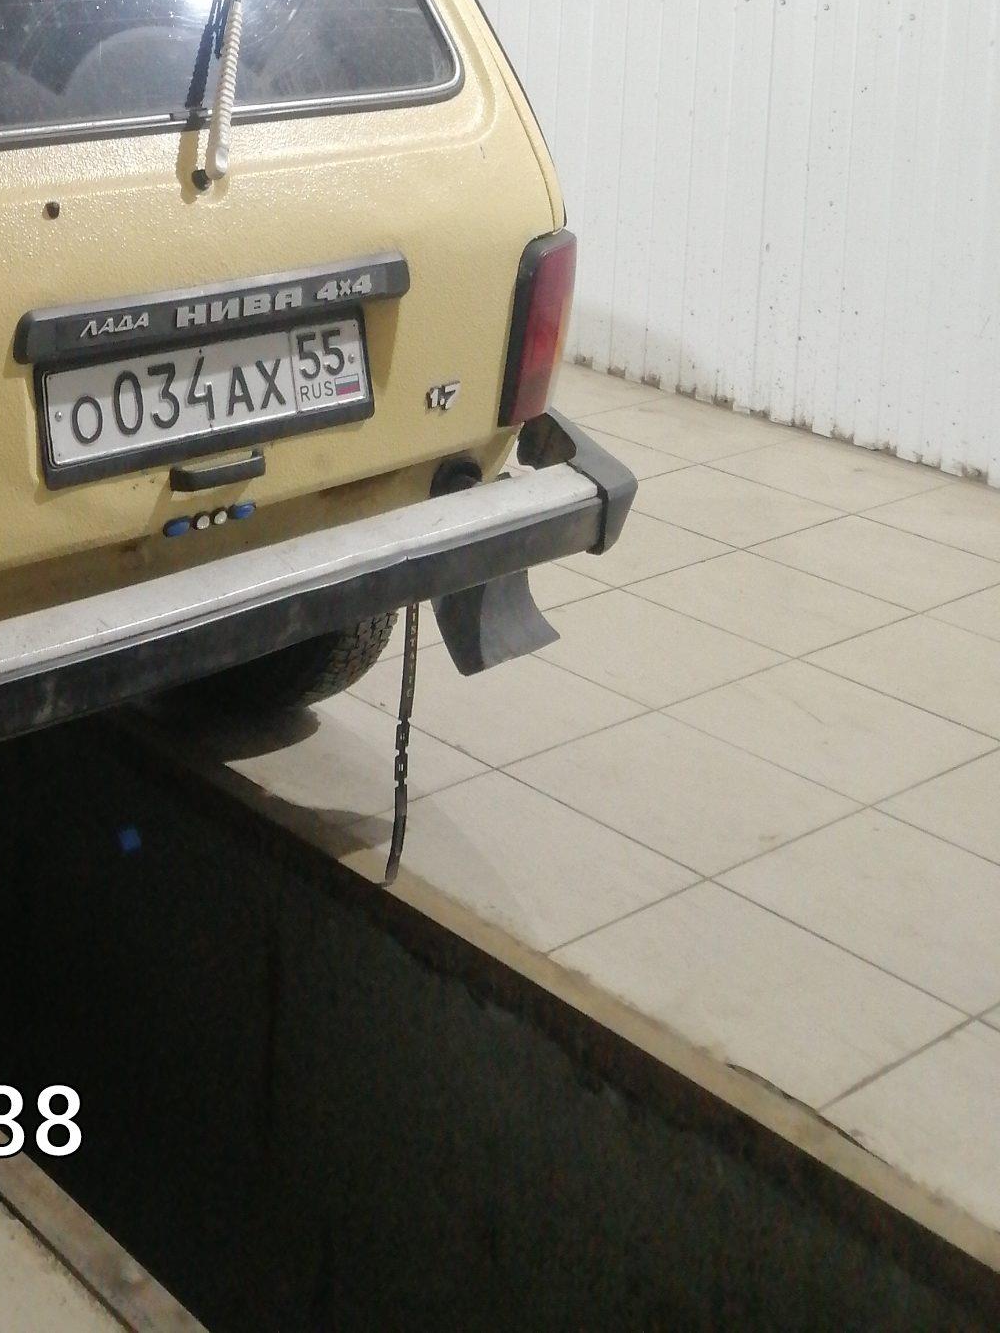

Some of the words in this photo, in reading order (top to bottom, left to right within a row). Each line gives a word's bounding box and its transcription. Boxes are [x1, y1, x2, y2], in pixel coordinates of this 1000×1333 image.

[80, 312, 150, 338] ЛАДА
[176, 287, 303, 328] НИВА
[297, 328, 346, 380] 55
[300, 384, 335, 402] RUS
